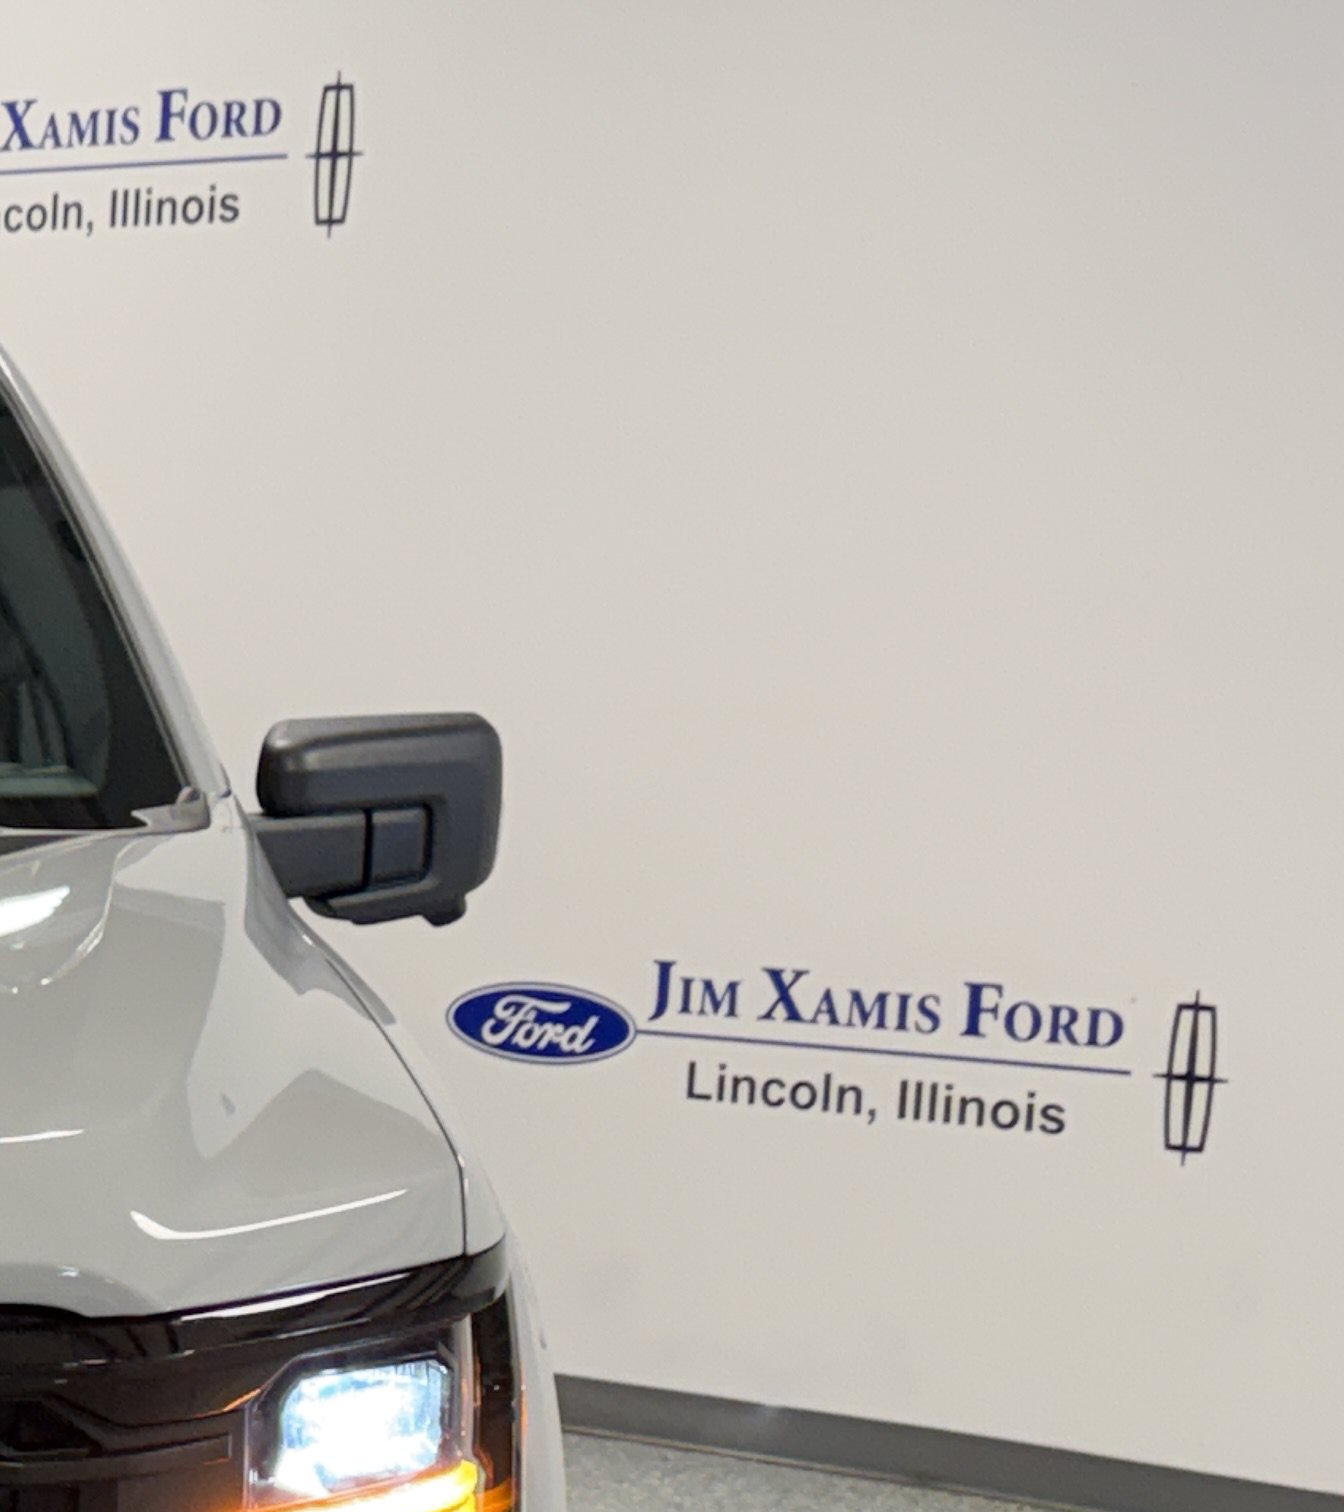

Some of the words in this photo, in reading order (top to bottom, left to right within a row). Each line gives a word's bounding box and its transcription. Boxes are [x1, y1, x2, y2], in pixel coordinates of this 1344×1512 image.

[0, 99, 140, 152] XAMIS
[156, 88, 282, 143] FORD
[109, 184, 240, 228] Illinois
[481, 994, 596, 1054] Ford
[648, 959, 741, 1023] JIM
[756, 967, 941, 1035] XAMIS
[962, 981, 1124, 1048] FORD
[686, 1061, 877, 1125] Lincoln,
[898, 1079, 1066, 1135] Illinois
